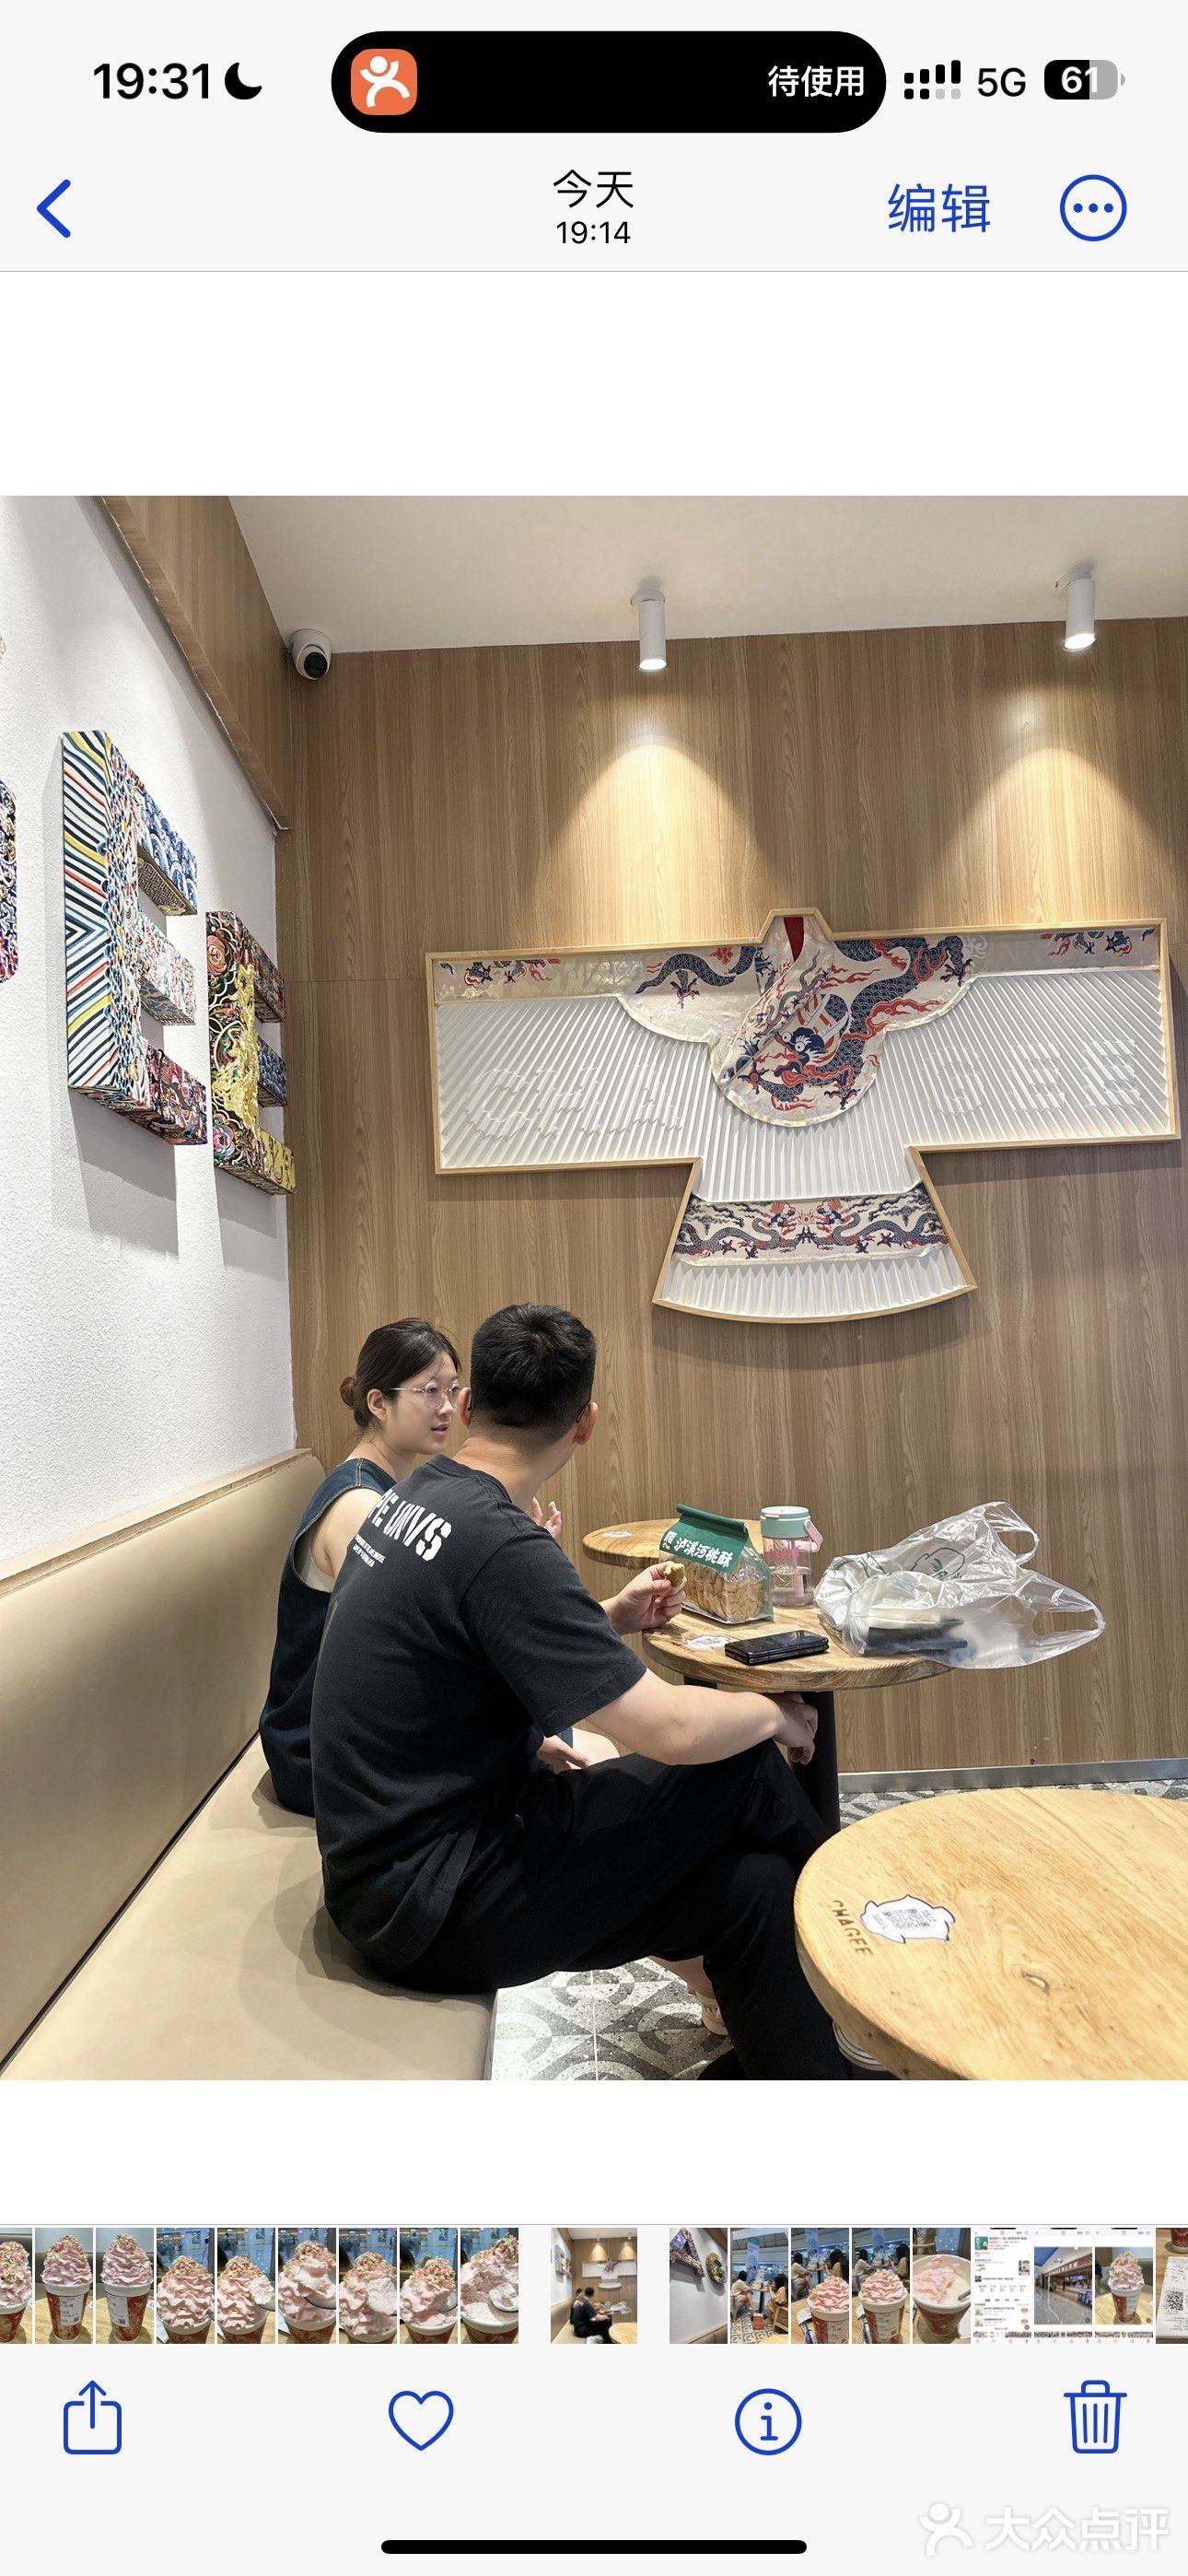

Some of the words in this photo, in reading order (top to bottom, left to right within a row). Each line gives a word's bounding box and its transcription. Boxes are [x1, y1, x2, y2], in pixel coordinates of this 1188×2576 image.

[94, 63, 214, 100] 19:31
[768, 65, 865, 97] 待使用
[978, 67, 1026, 97] 5G
[1061, 66, 1098, 93] 61
[553, 170, 635, 208] 今天
[888, 183, 991, 232] 编辑
[556, 221, 631, 244] 19:14
[832, 1899, 873, 1957] CHAGEE
